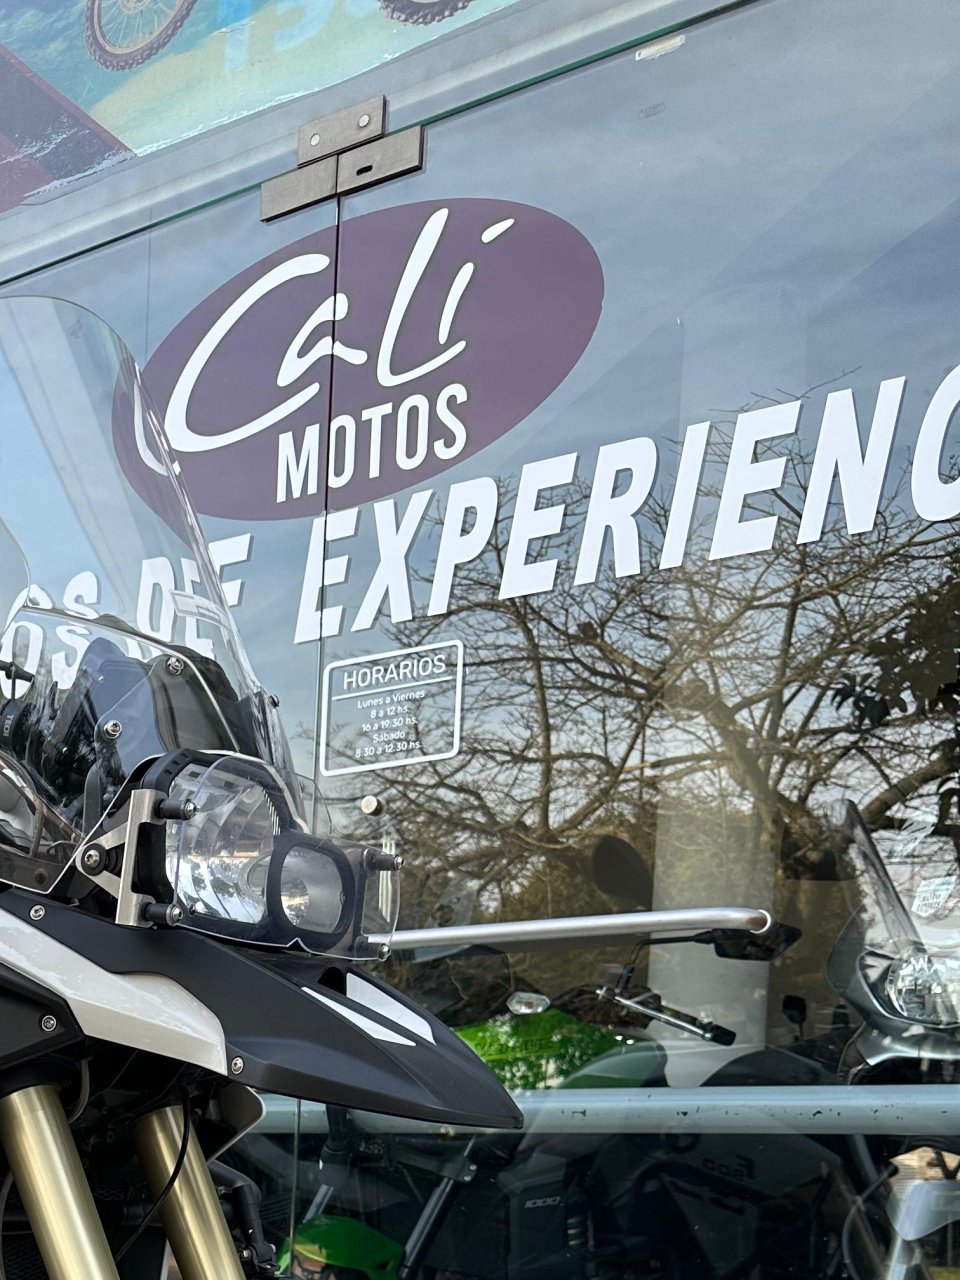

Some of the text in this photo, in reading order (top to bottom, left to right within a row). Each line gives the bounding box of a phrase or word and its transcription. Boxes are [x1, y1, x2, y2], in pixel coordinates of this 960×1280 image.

[276, 383, 468, 503] MOTOS
[343, 654, 447, 690] HORARIOS
[357, 697, 384, 709] Lunes
[392, 690, 425, 702] Viernes
[370, 709, 377, 719] 8
[386, 705, 396, 716] 12
[361, 722, 371, 732] 16
[524, 1196, 561, 1209] 1000
